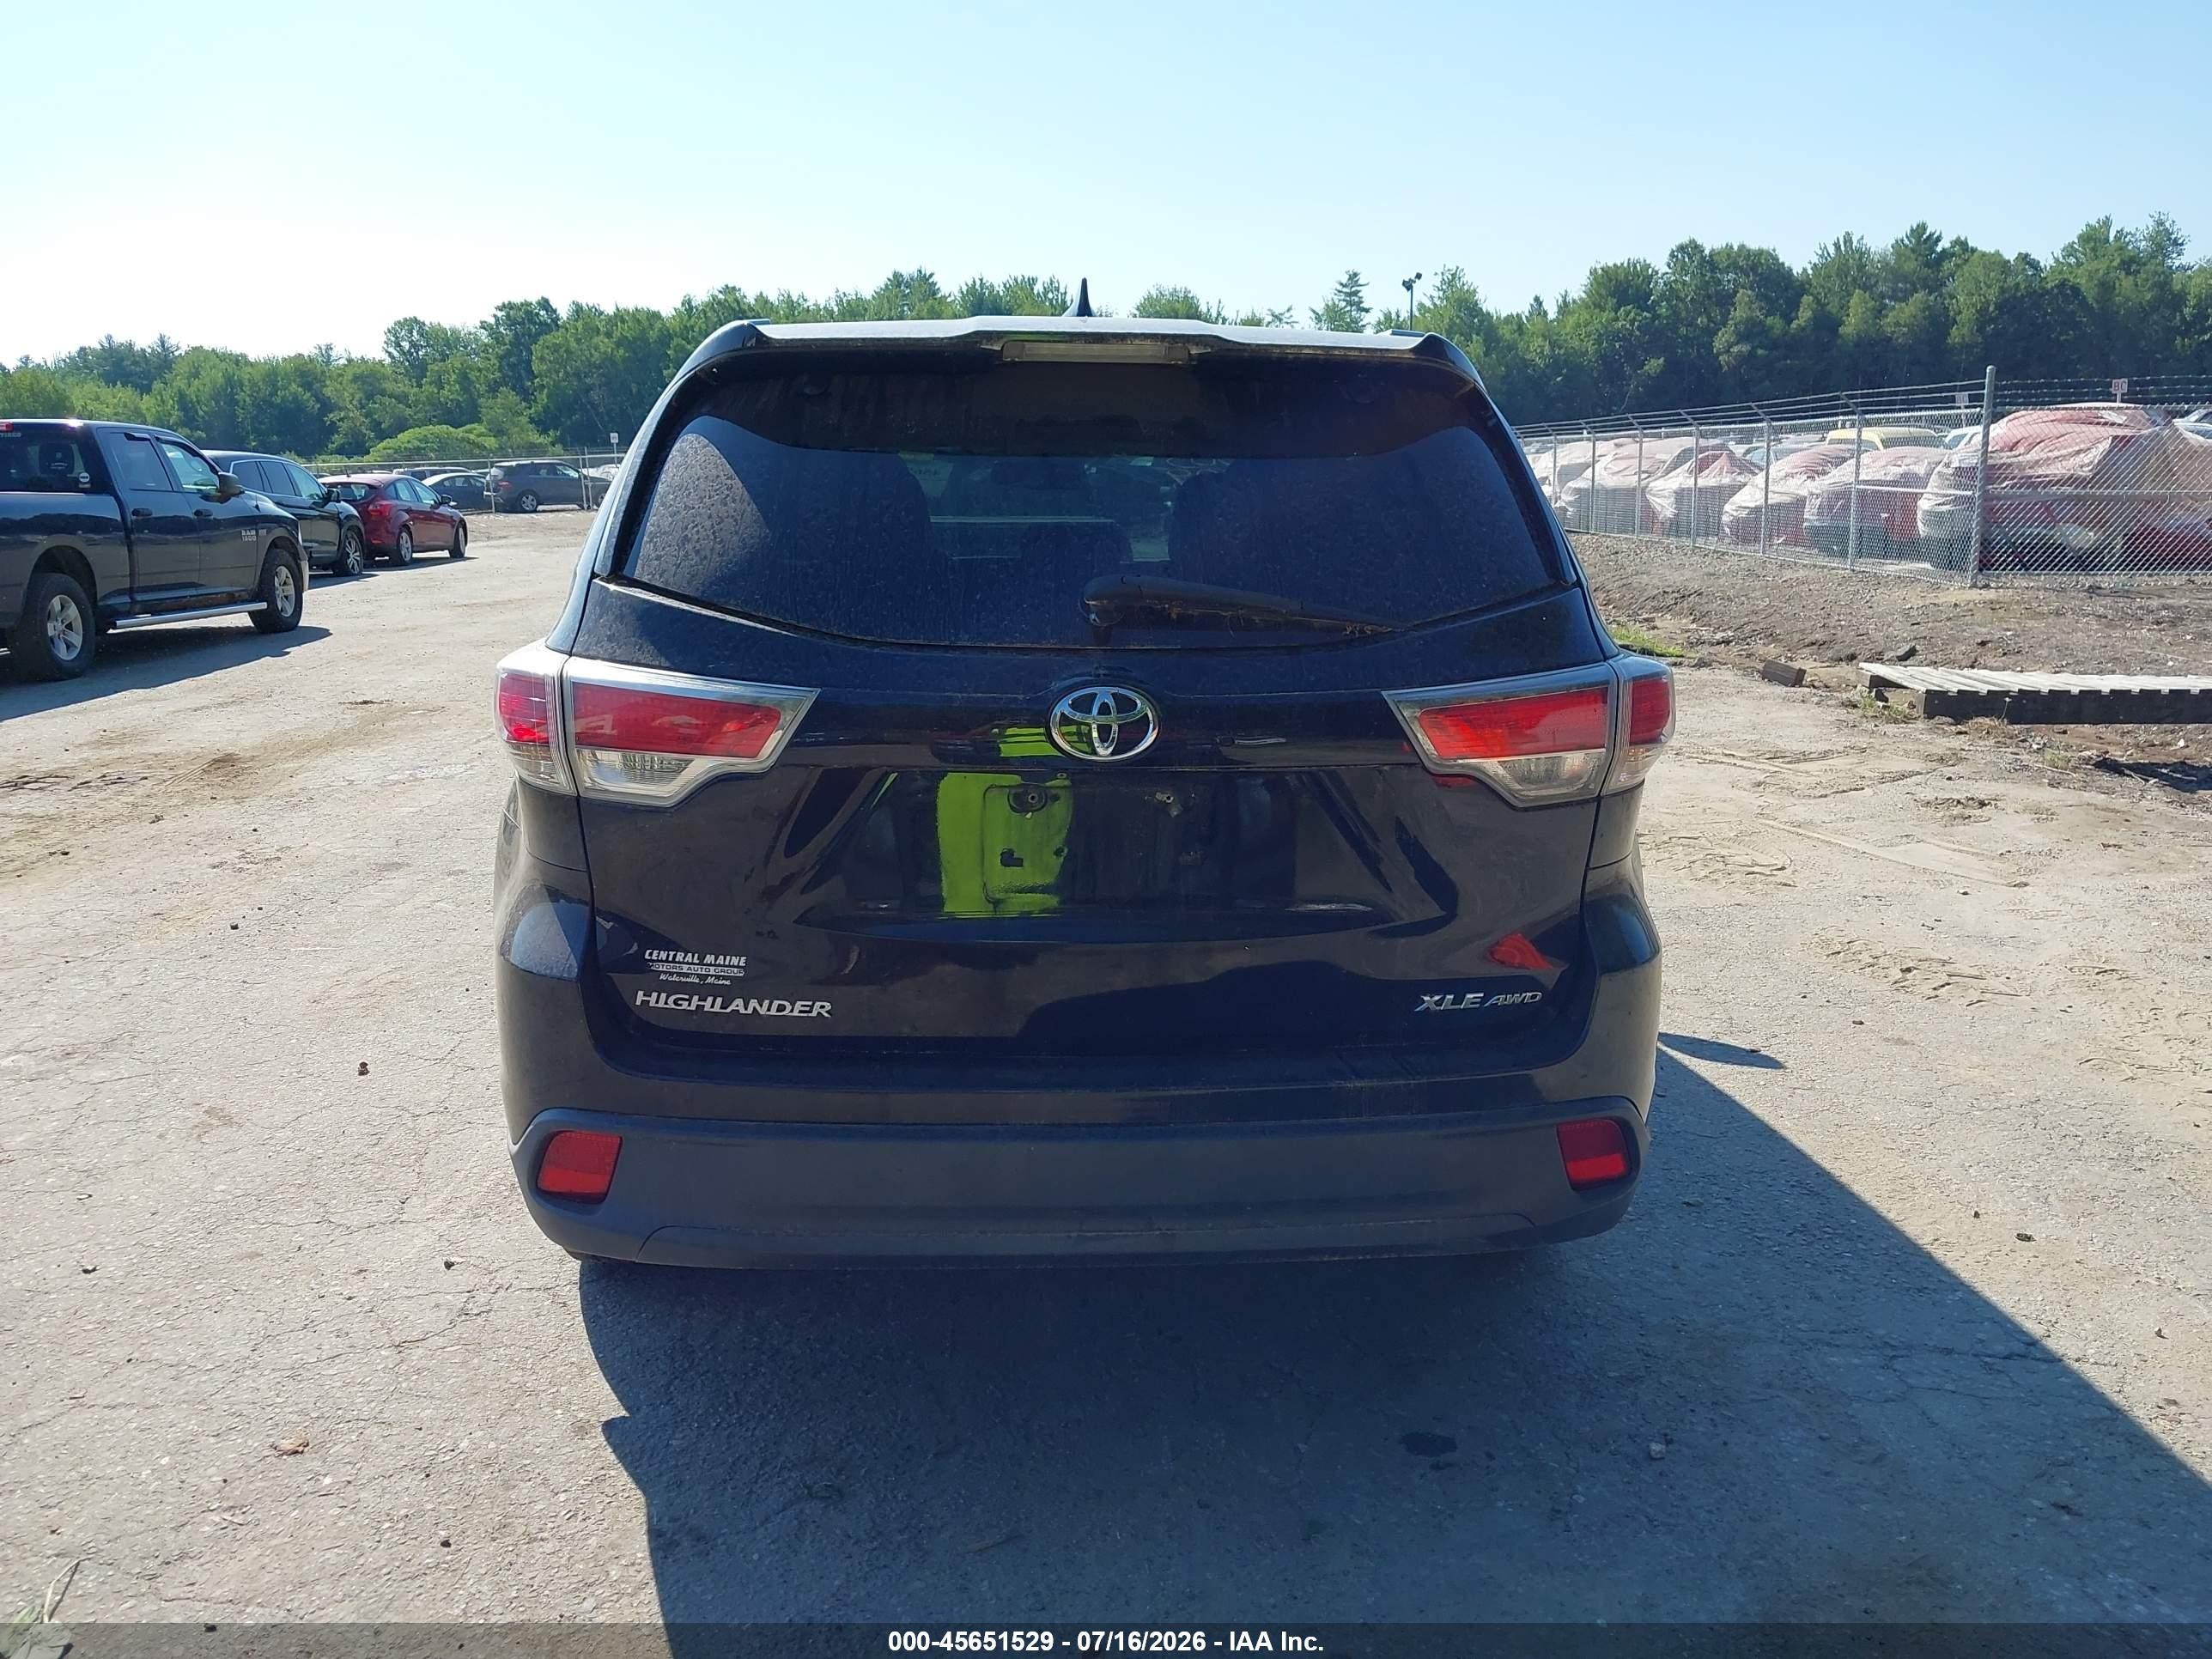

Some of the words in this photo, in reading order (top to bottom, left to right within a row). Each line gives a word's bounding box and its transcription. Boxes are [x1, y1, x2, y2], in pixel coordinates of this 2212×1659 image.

[644, 949, 700, 963] CENTRAL
[703, 954, 747, 967] MAINE
[659, 972, 703, 984] Waterville,
[705, 975, 732, 986] Maine
[686, 965, 712, 974] AUTO
[714, 967, 744, 976] GROUP
[635, 990, 832, 1018] HIGHLANDER
[1414, 992, 1484, 1012] XLE
[1484, 992, 1543, 1007] AWD
